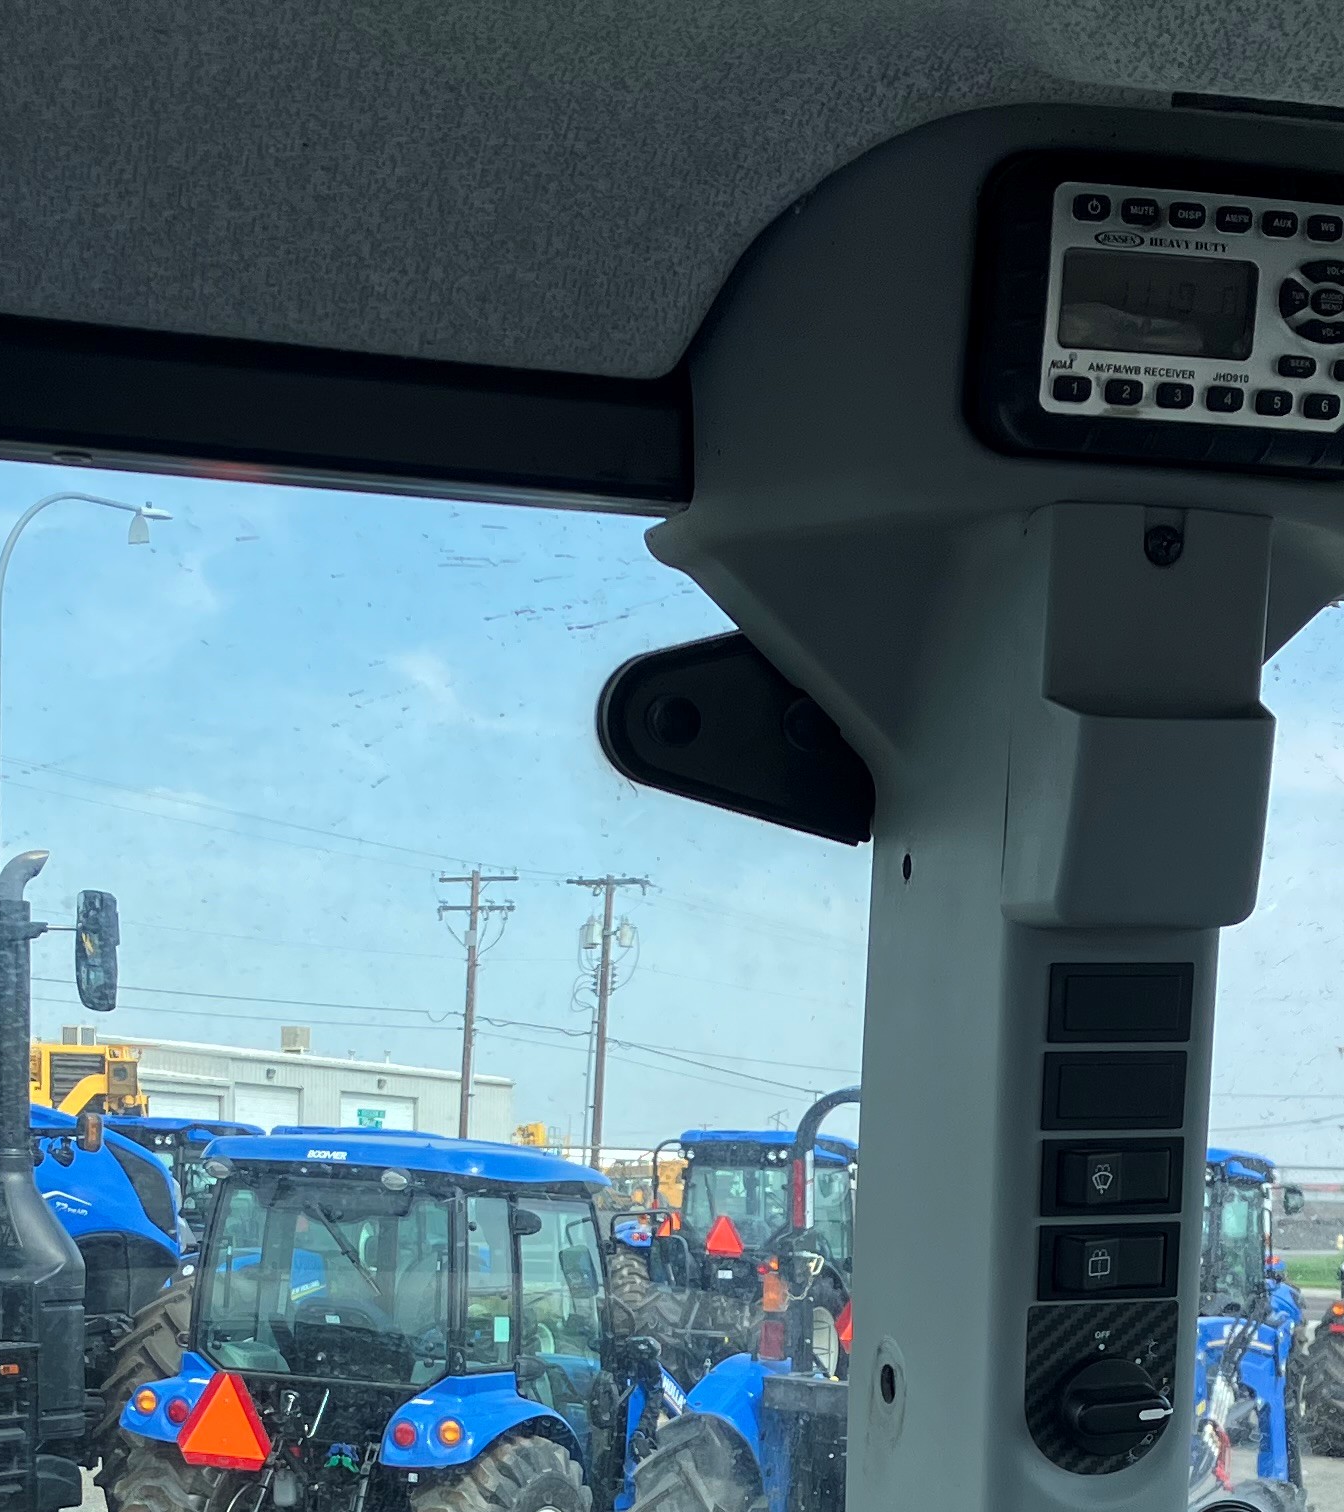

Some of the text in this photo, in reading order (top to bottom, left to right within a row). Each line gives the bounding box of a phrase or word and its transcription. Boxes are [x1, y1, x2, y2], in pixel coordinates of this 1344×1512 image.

[1130, 205, 1155, 216] MUTE
[1177, 209, 1202, 220] DISP
[1272, 218, 1293, 229] AUX
[1320, 222, 1336, 233] WB
[1149, 236, 1229, 253] HEAVY DUTY
[1087, 362, 1196, 379] AM/FM/WB RECEIVER
[1212, 372, 1250, 384] JHD910
[1071, 381, 1079, 395] 1
[1121, 384, 1131, 399] 2
[1173, 388, 1182, 402] 3
[1223, 391, 1233, 406] 4
[1273, 396, 1282, 409] 5
[1321, 400, 1329, 413] 6
[307, 1149, 348, 1161] BOOMER
[1094, 1330, 1111, 1339] OFF
